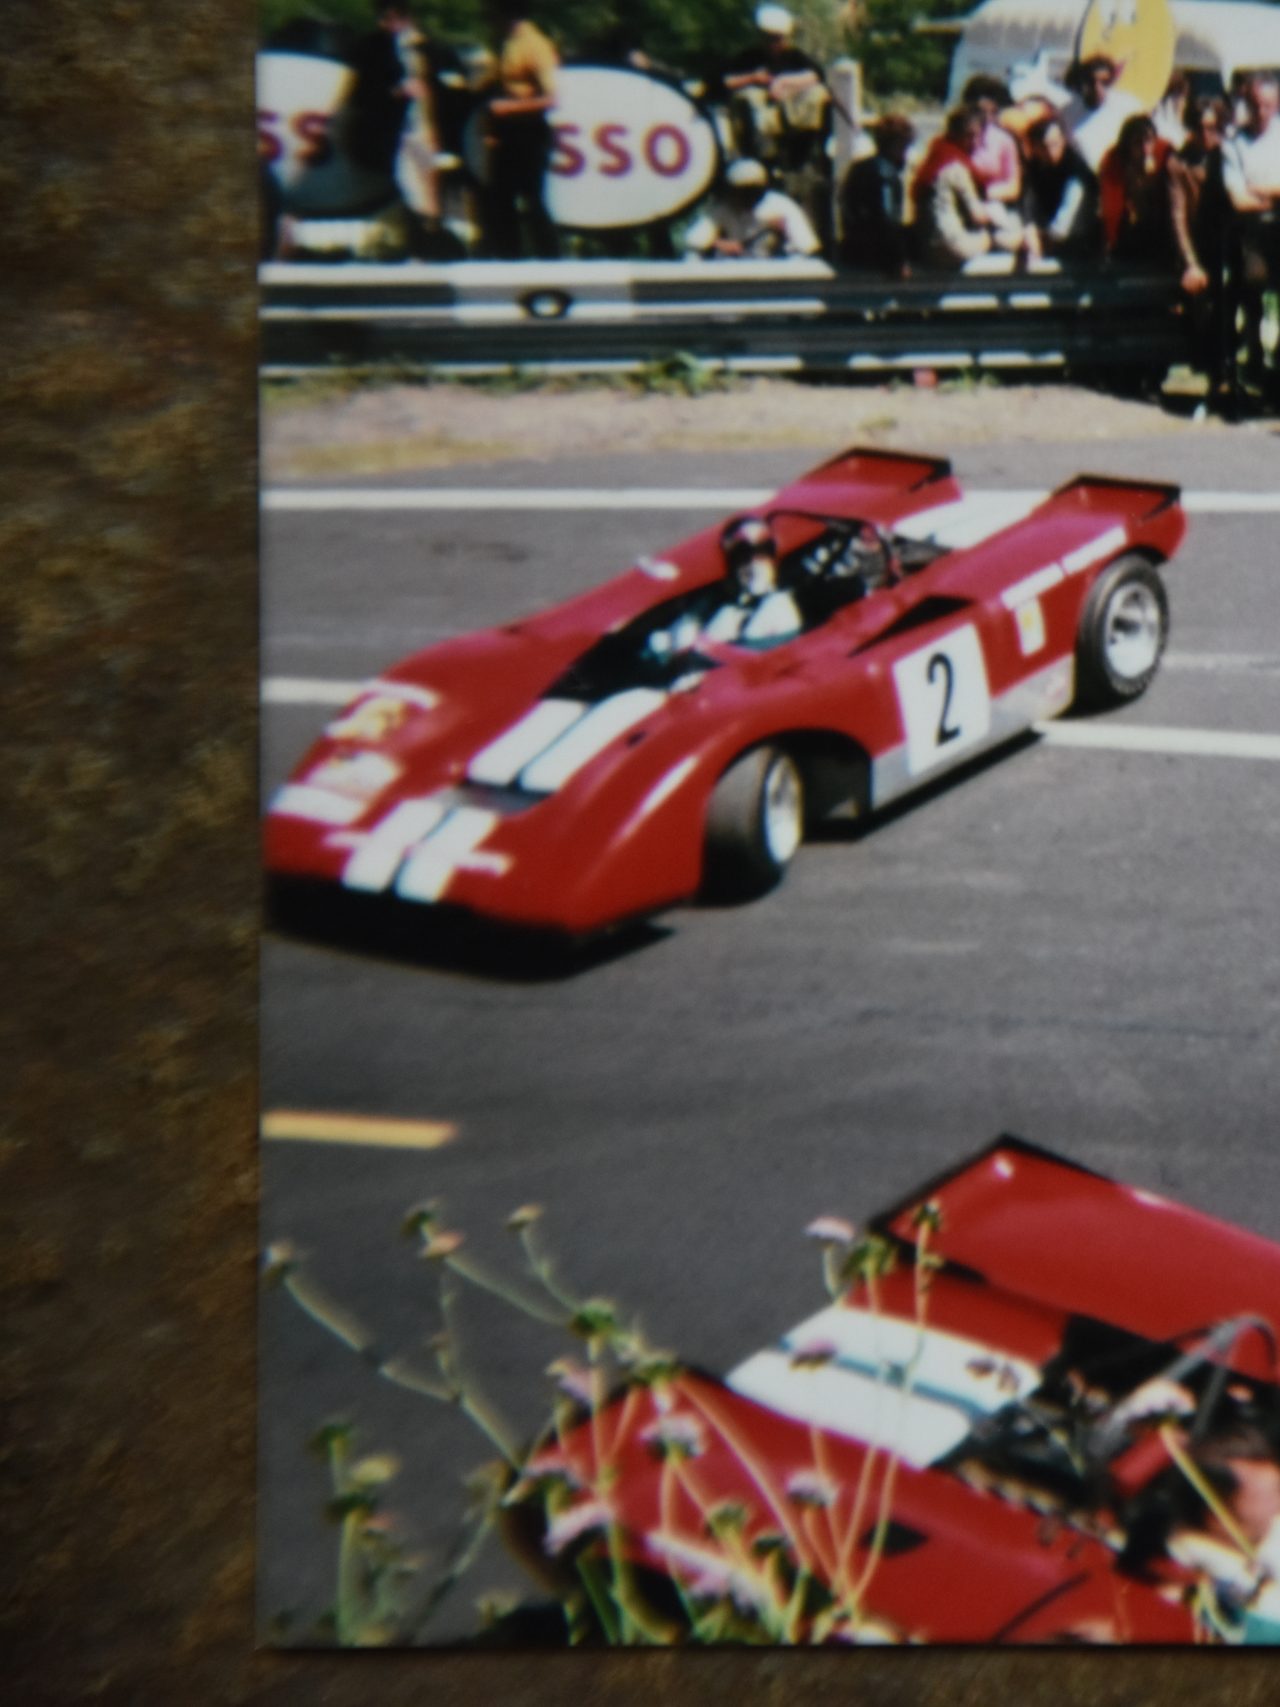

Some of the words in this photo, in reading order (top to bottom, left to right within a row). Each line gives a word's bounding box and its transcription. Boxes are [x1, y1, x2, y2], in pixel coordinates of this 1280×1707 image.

[257, 111, 331, 167] SS
[551, 122, 692, 180] SSO
[926, 652, 961, 746] 2
